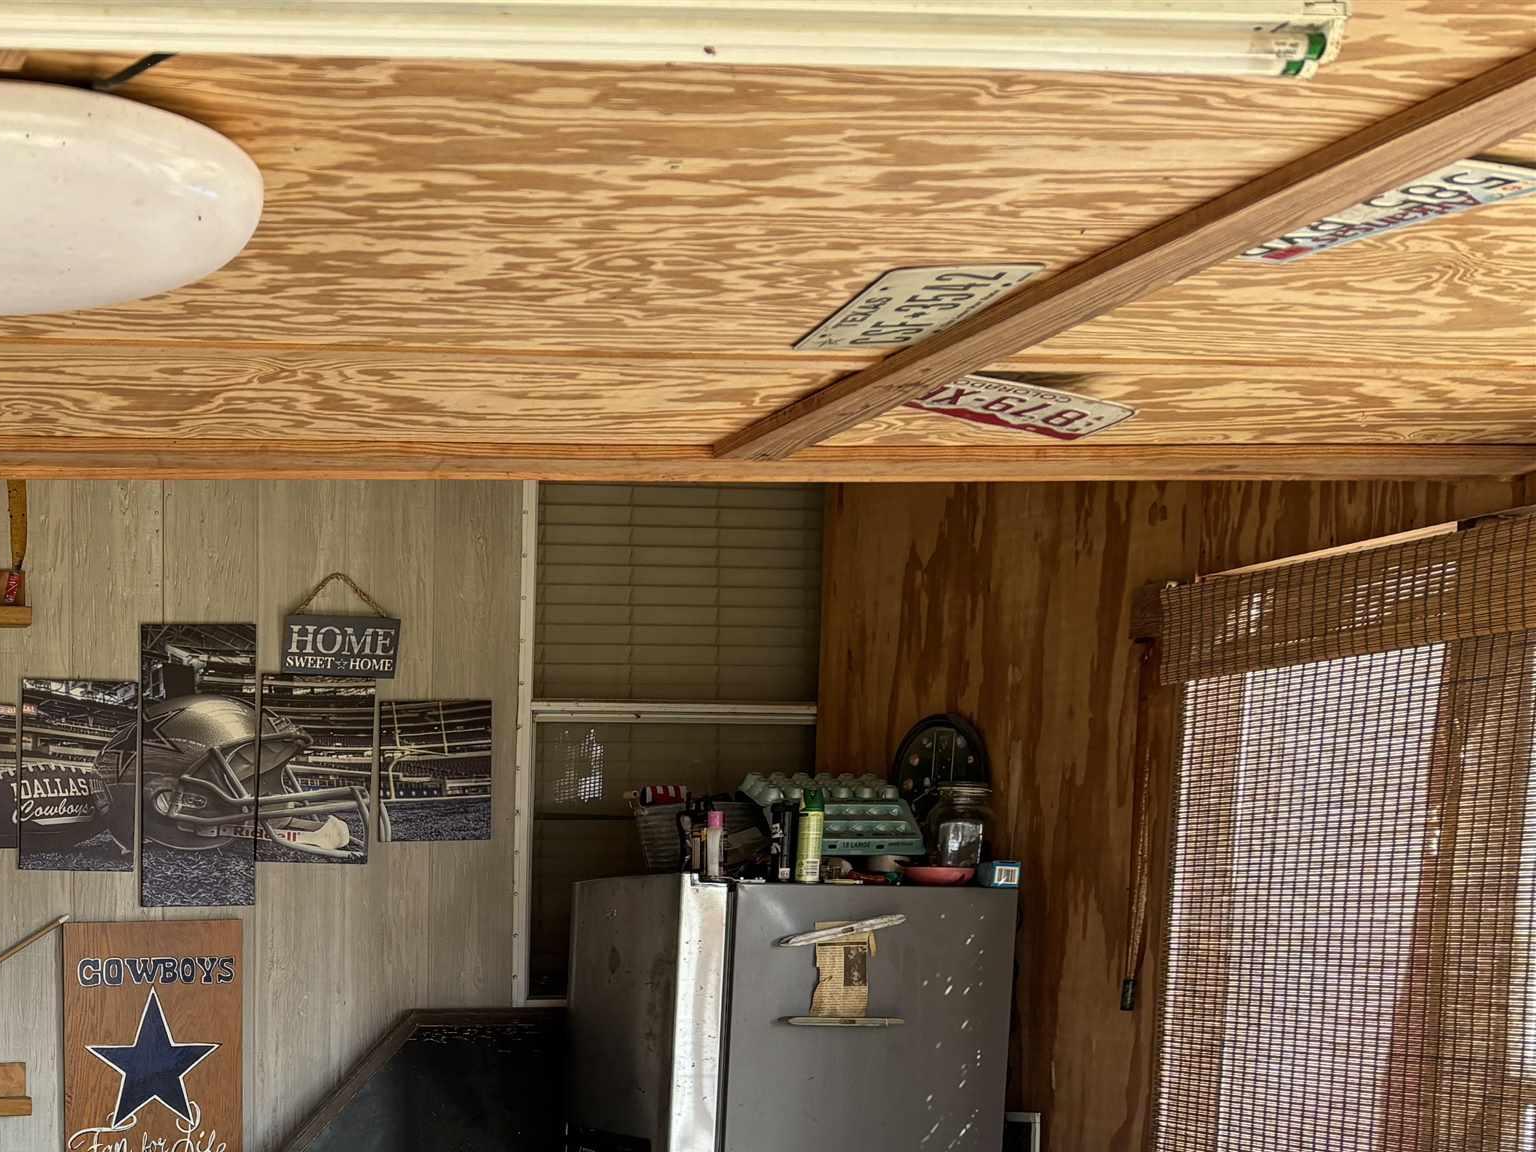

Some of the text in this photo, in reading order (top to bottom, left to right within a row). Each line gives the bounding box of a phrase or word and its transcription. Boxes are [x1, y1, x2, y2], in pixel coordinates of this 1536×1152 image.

[833, 297, 892, 329] TEXAS
[952, 380, 1072, 403] COLORADO
[287, 625, 396, 656] HOME
[285, 655, 394, 671] SWEET HOME
[11, 778, 90, 800] DALLAS
[12, 798, 91, 824] Cowboys
